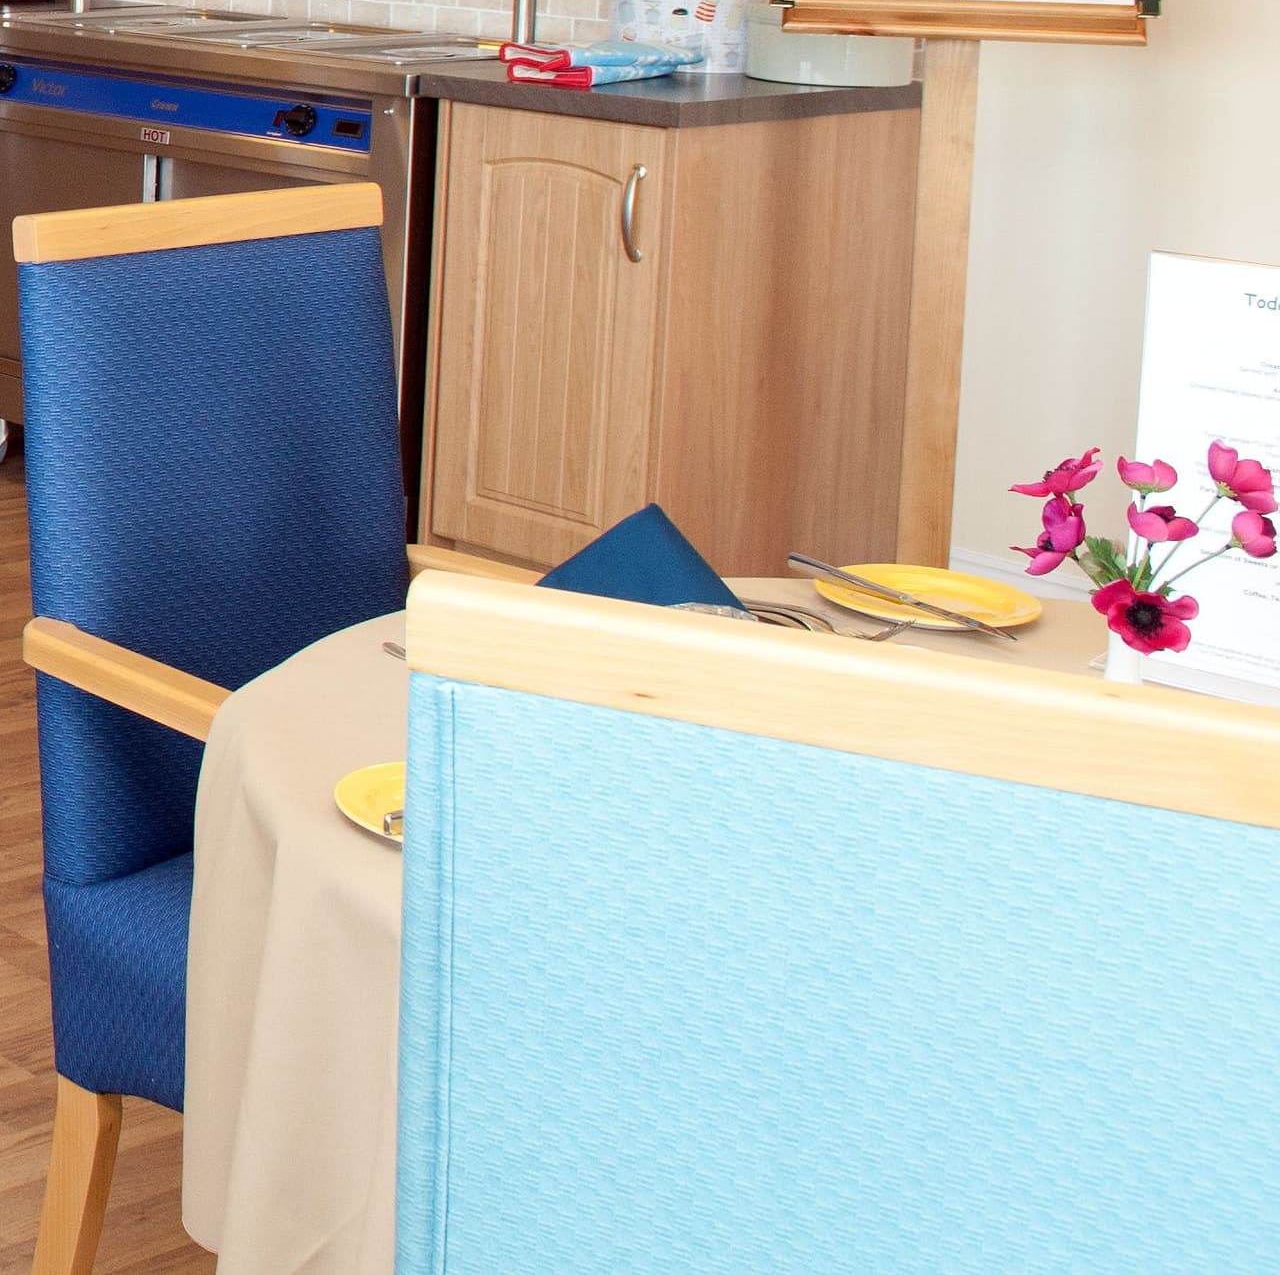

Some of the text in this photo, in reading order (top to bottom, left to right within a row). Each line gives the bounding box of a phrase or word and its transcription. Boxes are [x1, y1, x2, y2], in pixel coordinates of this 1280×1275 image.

[31, 77, 67, 96] Victor
[142, 129, 166, 143] HOT
[1243, 292, 1280, 311] Tod
